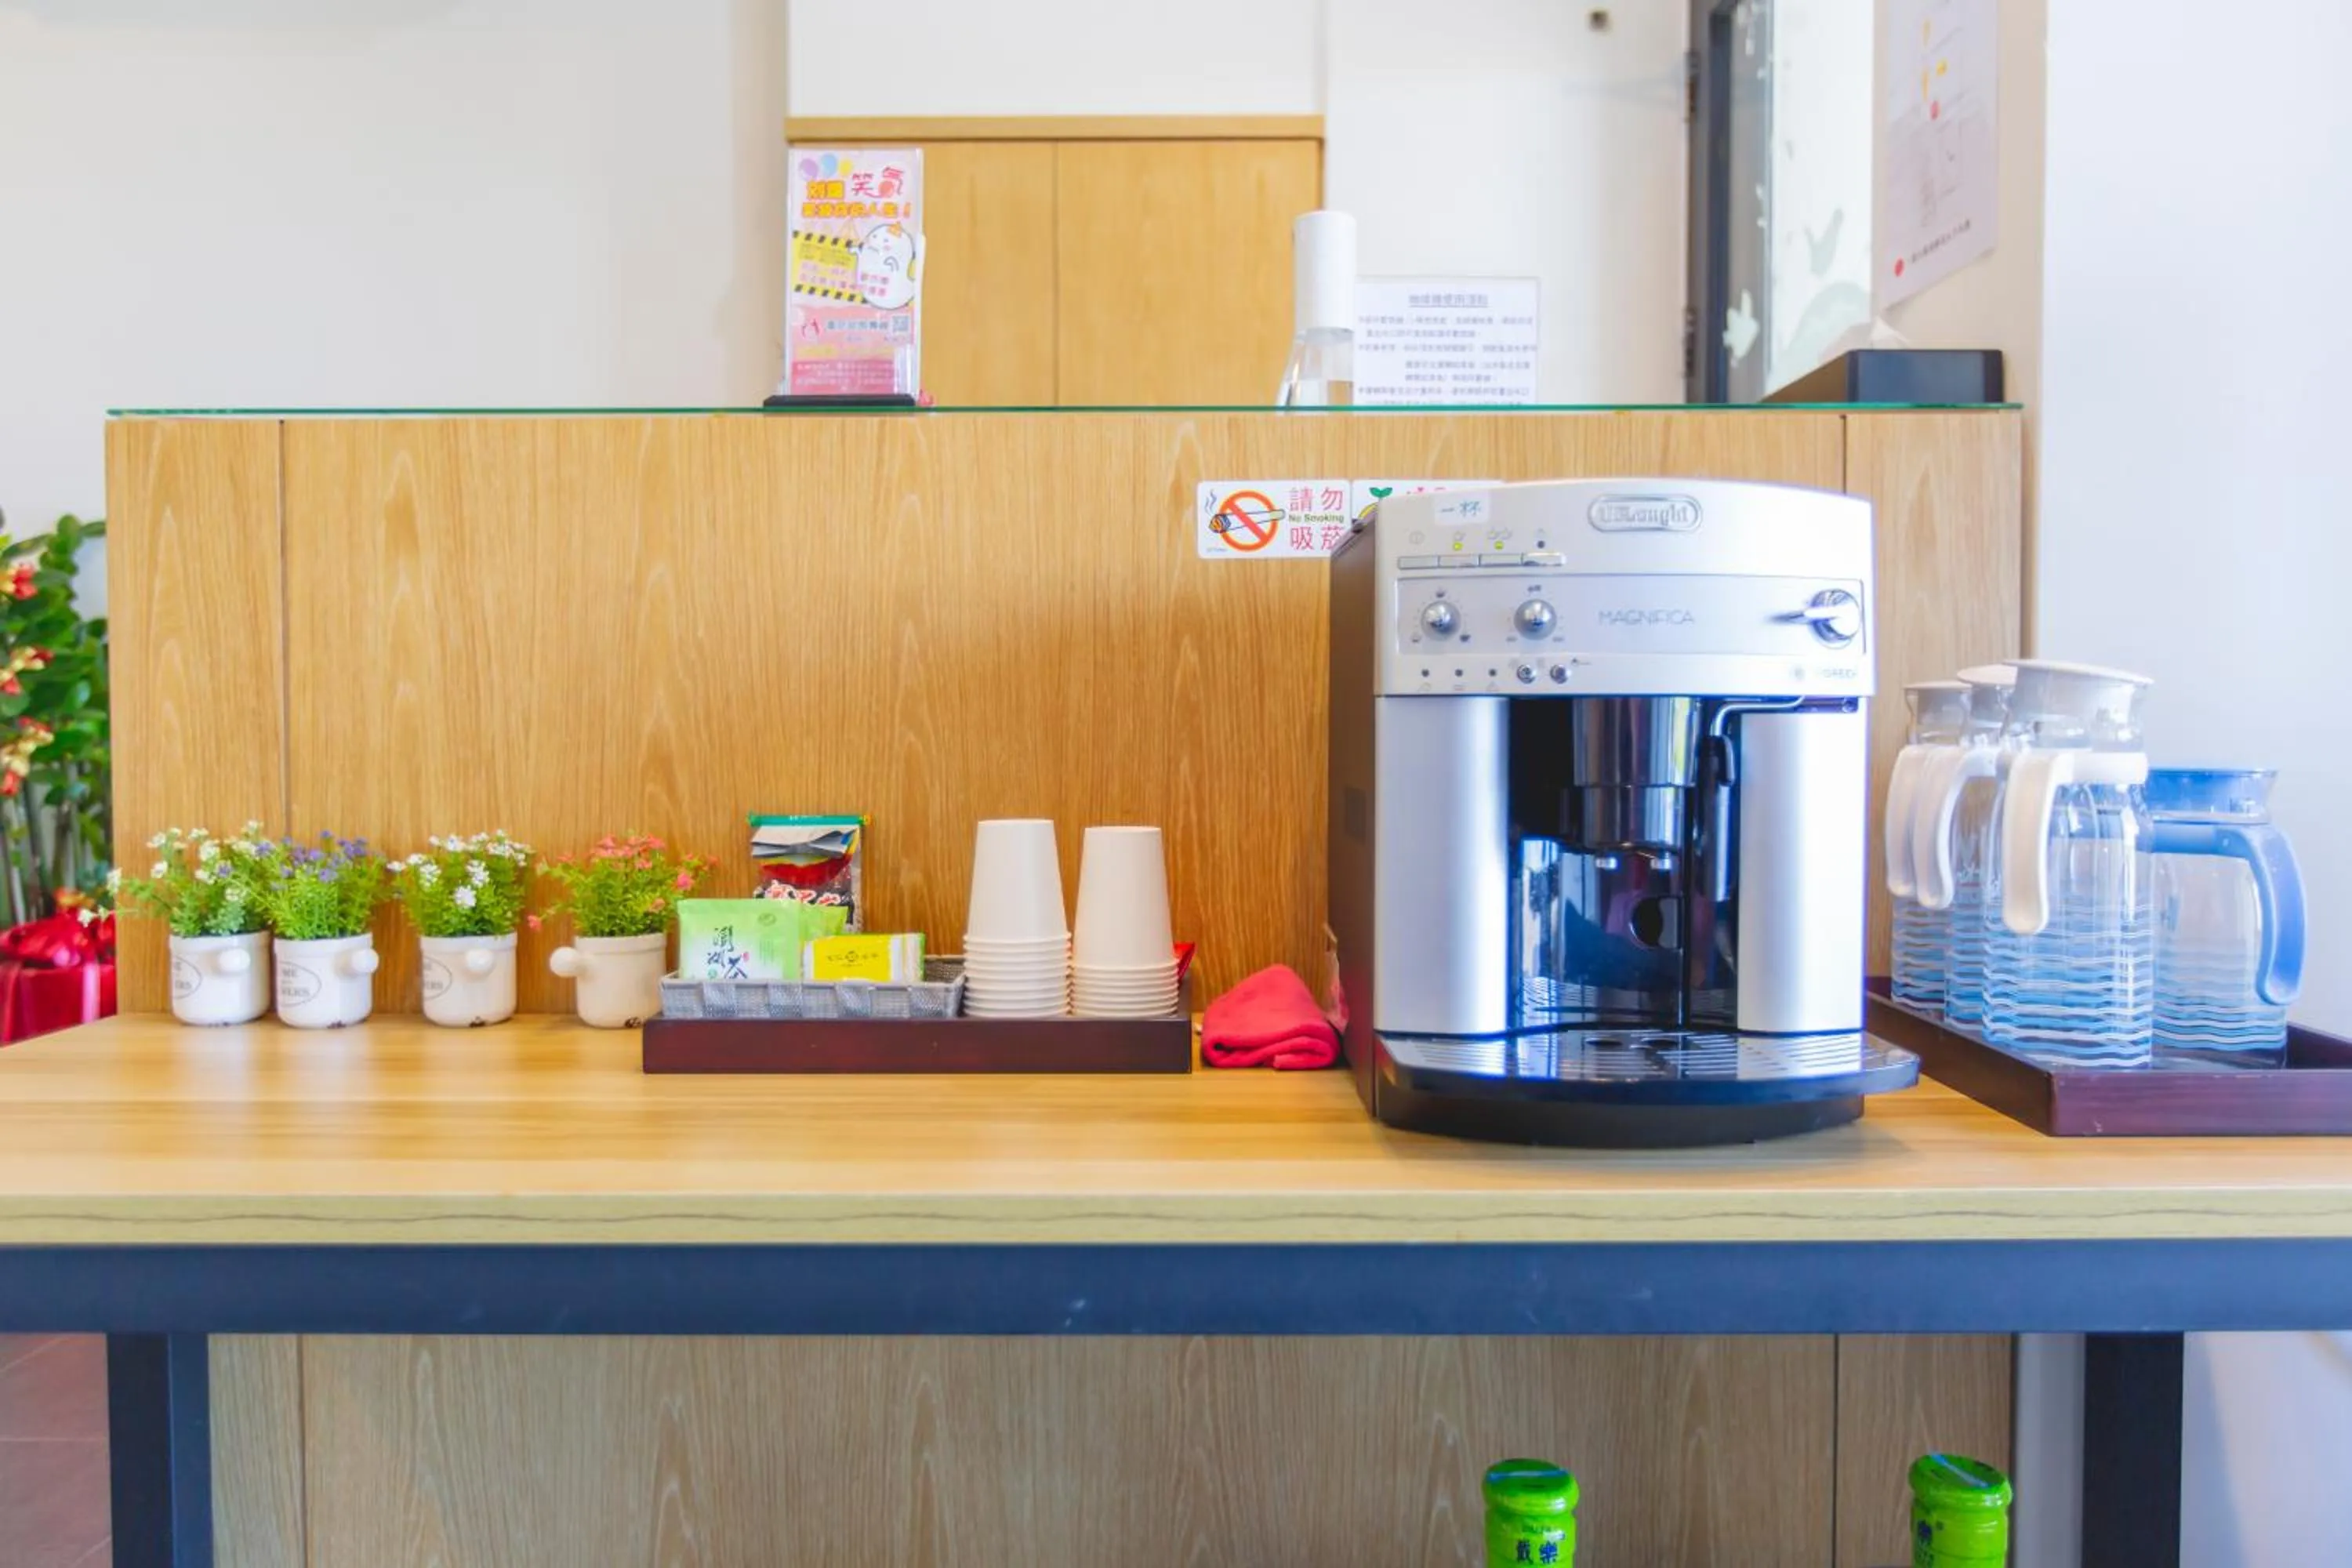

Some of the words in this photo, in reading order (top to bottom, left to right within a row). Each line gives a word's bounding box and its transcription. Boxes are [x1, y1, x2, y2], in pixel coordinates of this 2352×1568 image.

[1289, 487, 1344, 512] 請勿
[1440, 500, 1481, 517] 一杯
[1289, 514, 1302, 524] No
[1305, 514, 1345, 524] Smoking
[1599, 608, 1695, 626] MAGNIFICA
